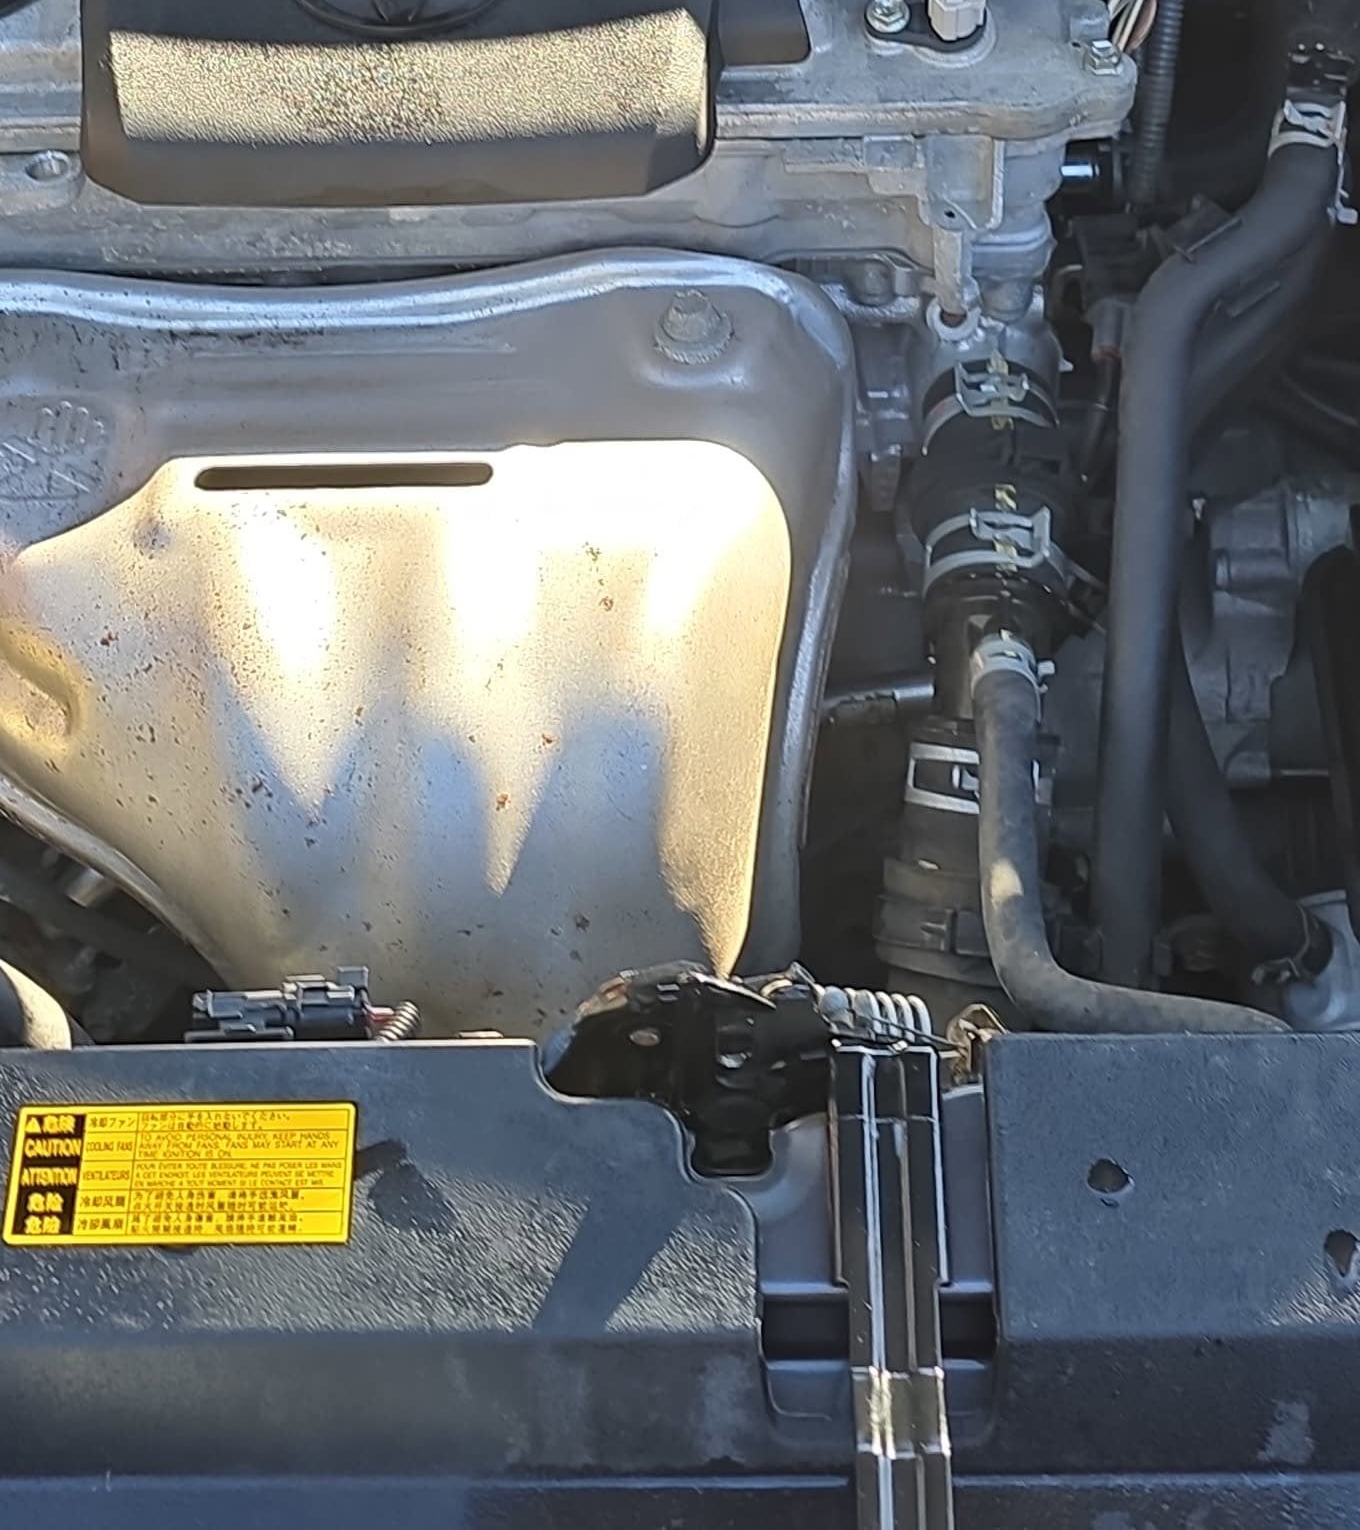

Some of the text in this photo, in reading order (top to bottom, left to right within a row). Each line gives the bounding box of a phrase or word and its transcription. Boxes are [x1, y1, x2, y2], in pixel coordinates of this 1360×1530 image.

[90, 1117, 136, 1128] 冷却ファン
[156, 1132, 182, 1141] AVOID
[186, 1132, 230, 1141] PERSONAL
[273, 1132, 296, 1141] KEEP
[300, 1132, 330, 1141] HANDS
[24, 1138, 82, 1158] CAUTION
[87, 1141, 133, 1152] COOLING FANS
[252, 1141, 270, 1150] MAY
[275, 1141, 303, 1150] START
[307, 1141, 319, 1150] AT
[320, 1141, 339, 1150] ANY
[162, 1150, 201, 1158] IGNITION
[20, 1167, 78, 1187] ATTENTION
[82, 1171, 130, 1181] VENTILATEURS
